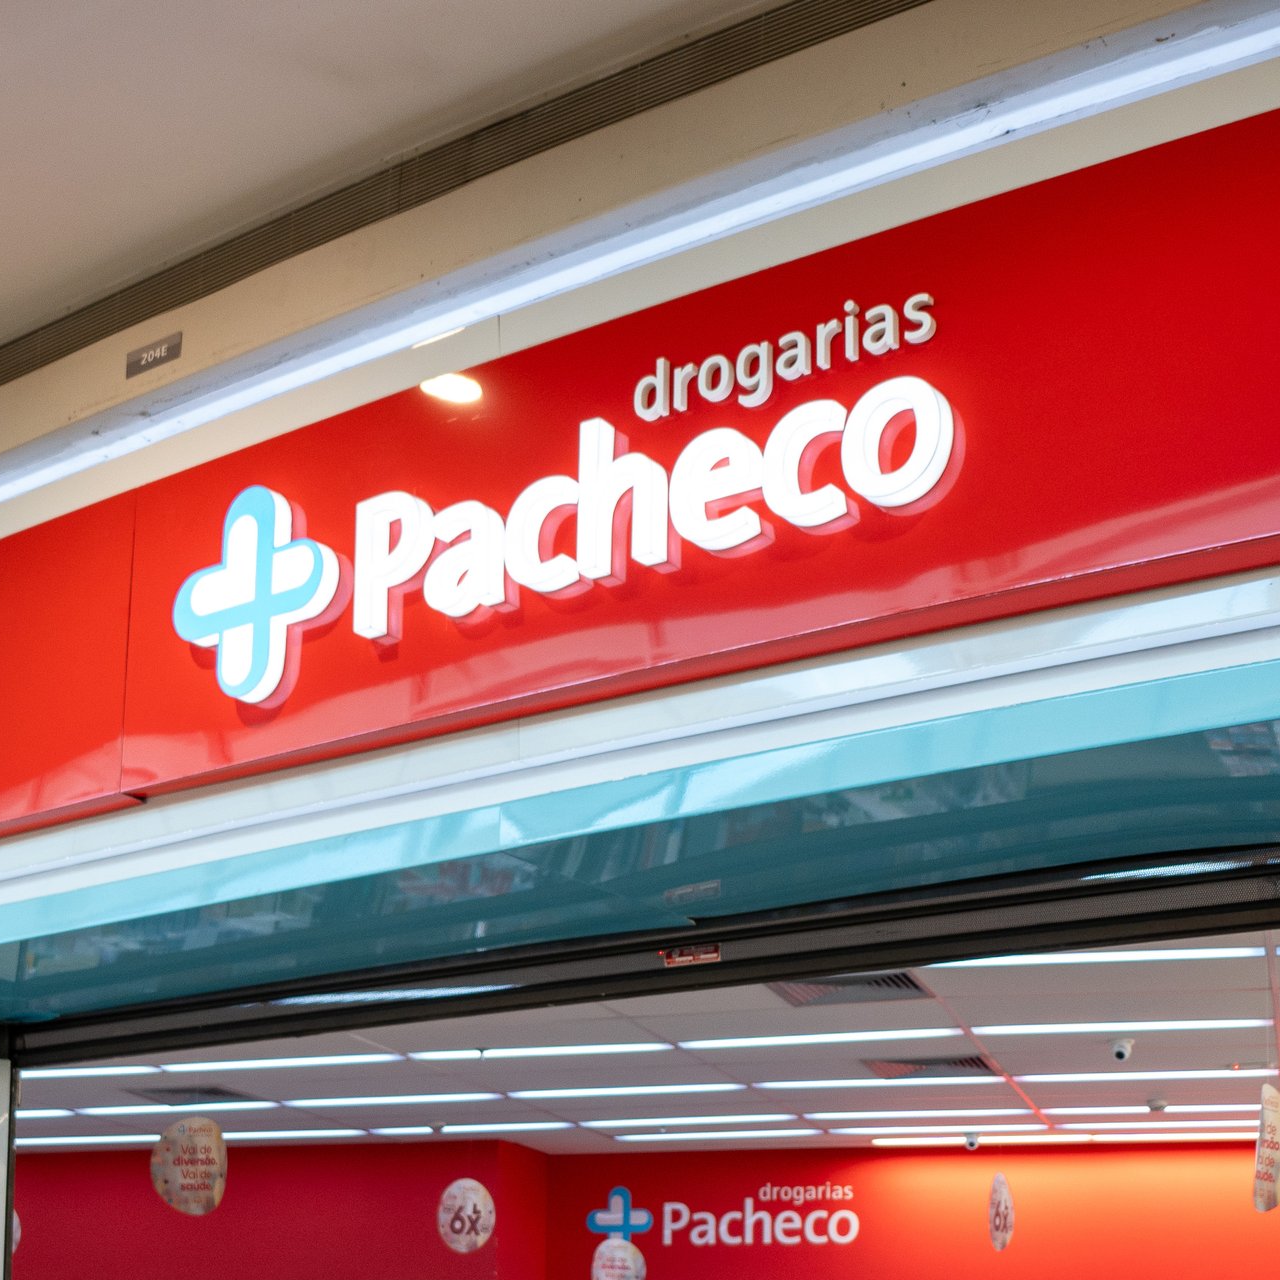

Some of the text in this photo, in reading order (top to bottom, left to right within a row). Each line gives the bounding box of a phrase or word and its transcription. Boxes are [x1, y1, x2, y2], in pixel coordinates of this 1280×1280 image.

[141, 344, 168, 366] 204E
[634, 292, 937, 422] drogarias
[353, 376, 958, 643] Pacheco
[758, 1181, 853, 1206] drogarias
[662, 1197, 860, 1246] Pacheco
